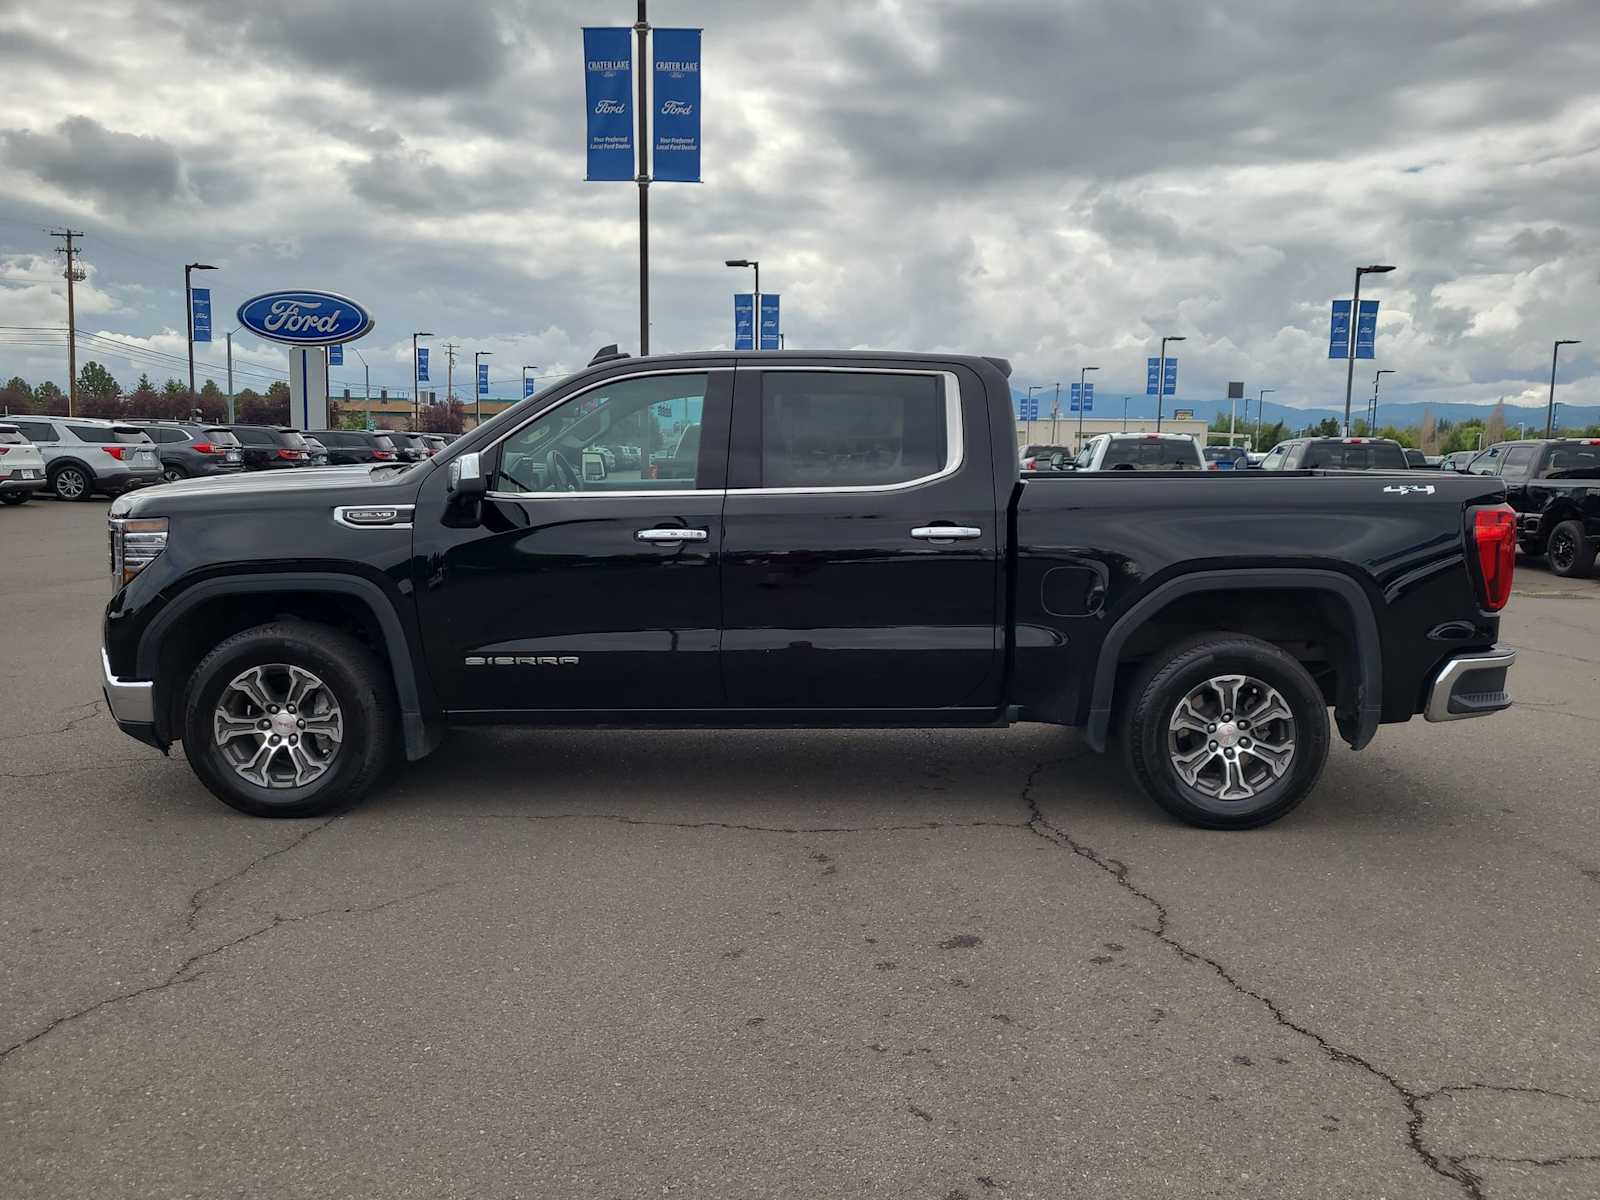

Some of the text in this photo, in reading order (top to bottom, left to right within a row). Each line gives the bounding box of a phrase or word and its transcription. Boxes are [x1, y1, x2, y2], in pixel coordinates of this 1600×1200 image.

[588, 61, 630, 71] CRATER LAKE
[656, 62, 699, 72] CRATER LAKE
[595, 99, 625, 114] Ford
[661, 100, 693, 115] Ford
[264, 300, 341, 333] Ford
[465, 656, 580, 665] SIERRA
